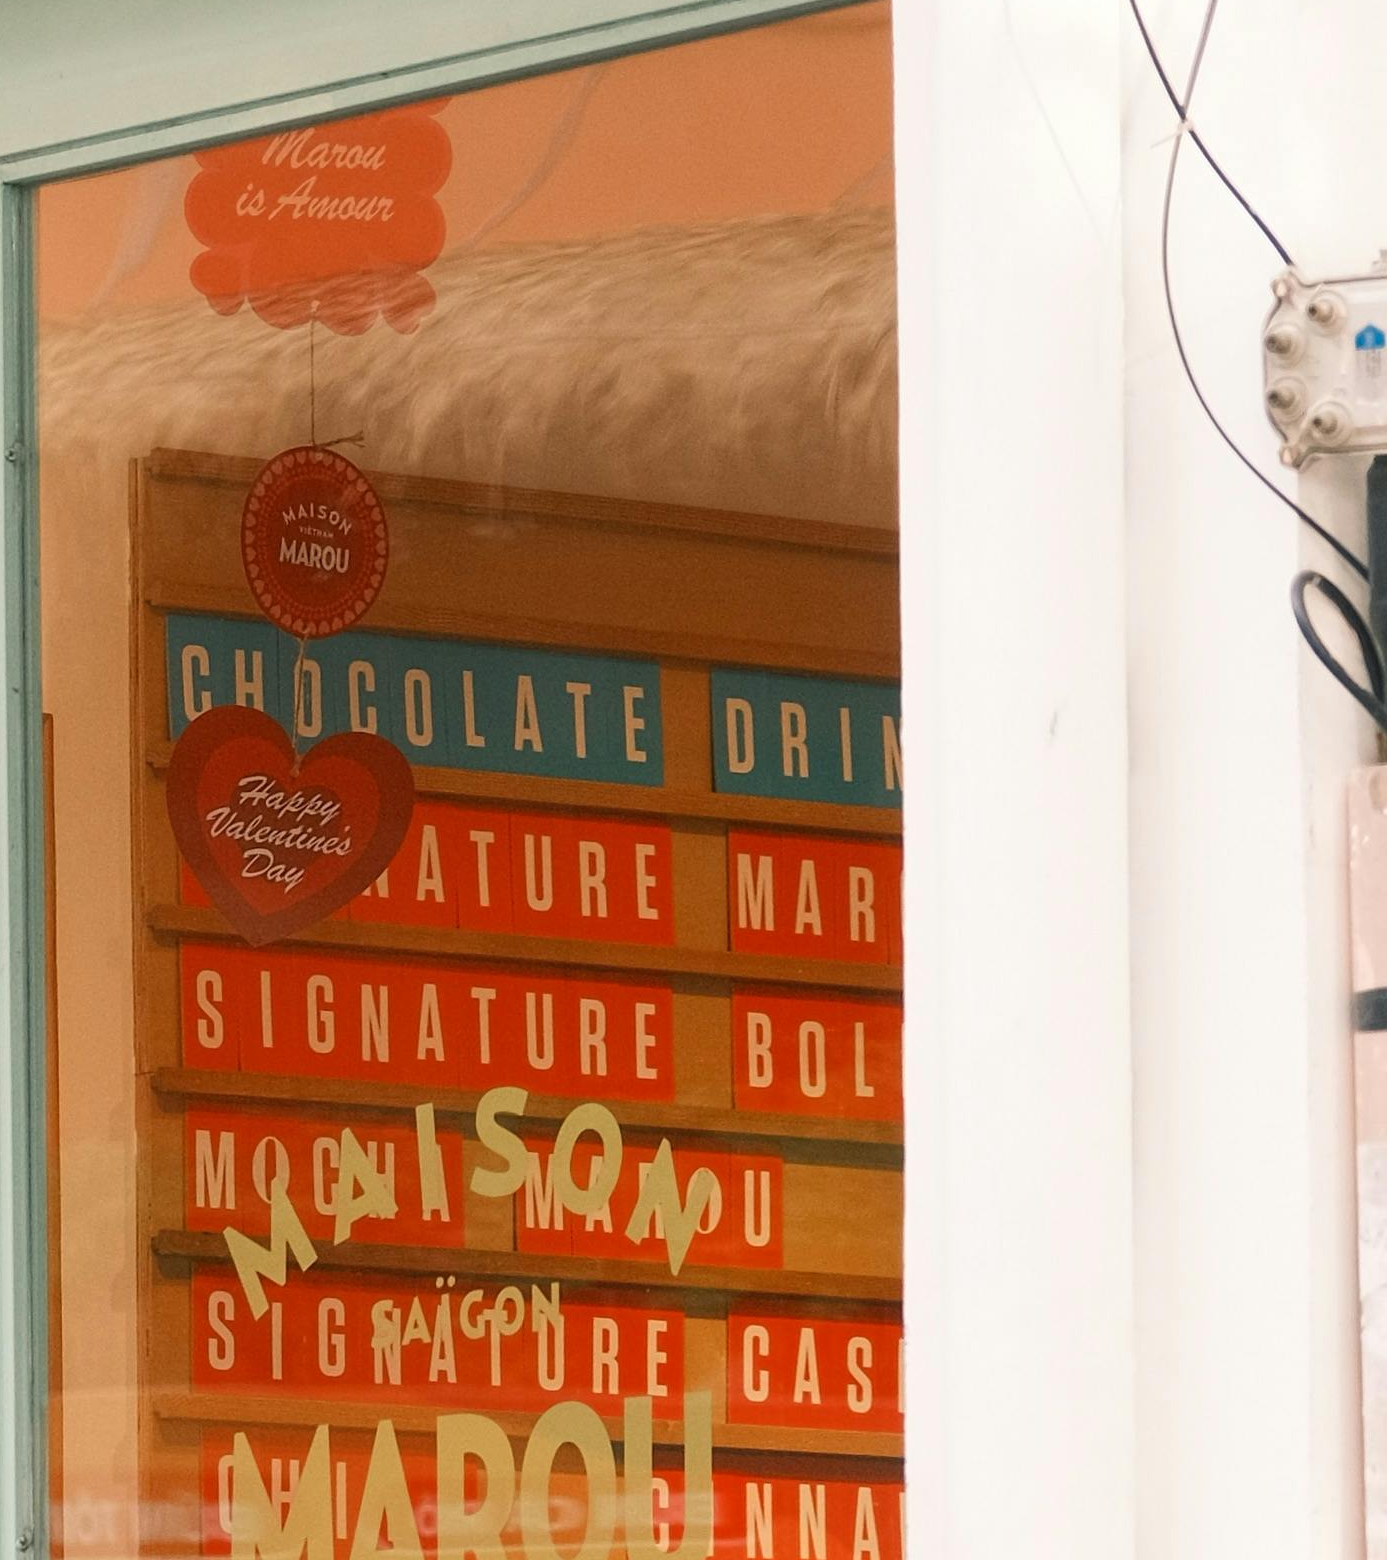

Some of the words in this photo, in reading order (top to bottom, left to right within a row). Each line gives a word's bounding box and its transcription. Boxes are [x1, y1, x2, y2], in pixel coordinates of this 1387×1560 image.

[262, 127, 386, 170] Marou
[236, 183, 267, 216] is
[268, 175, 394, 222] Amour
[282, 502, 353, 536] MAISON
[279, 537, 349, 574] MAROU
[181, 644, 647, 763] CHOCOLATE
[726, 697, 904, 791] DRIN
[238, 775, 340, 824] Happy
[205, 806, 352, 856] Valentine's
[241, 848, 305, 894] Day
[361, 824, 660, 920] ATURE
[737, 853, 876, 942] MAR
[195, 970, 659, 1081] SIGNATURE
[747, 1012, 875, 1098] BOL
[223, 1086, 715, 1321] MAISON
[207, 1289, 668, 1397] SIGNATURE
[742, 1325, 904, 1414] CAS
